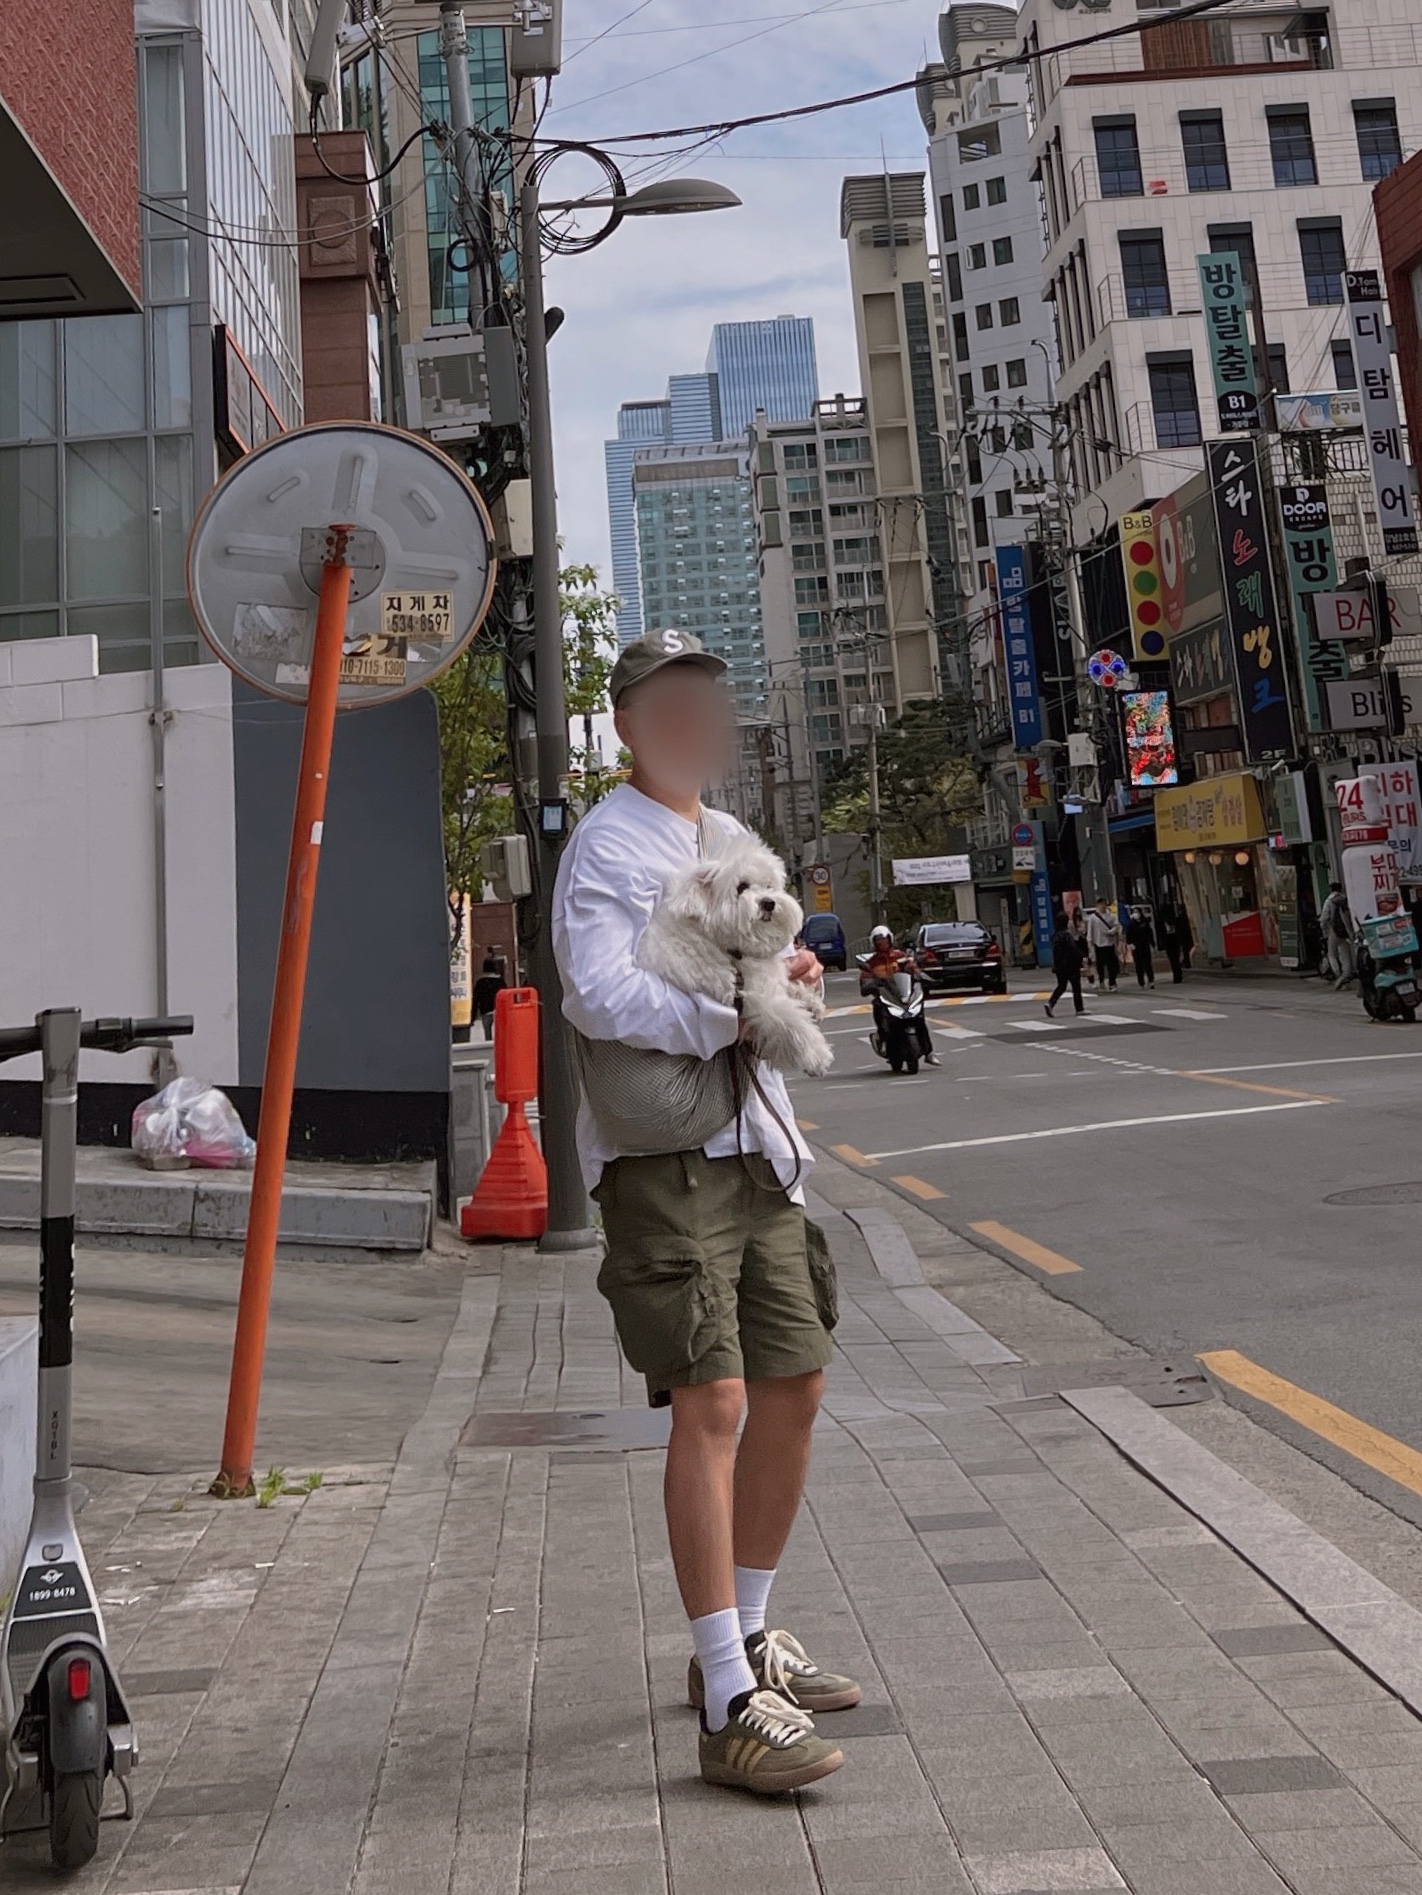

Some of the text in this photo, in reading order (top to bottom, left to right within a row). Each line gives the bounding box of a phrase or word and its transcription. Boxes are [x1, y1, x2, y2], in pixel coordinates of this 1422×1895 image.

[1202, 263, 1248, 382] 방탈출
[1228, 394, 1246, 410] B1
[1355, 312, 1408, 518] 디탐헤어
[1283, 501, 1327, 516] DOOR
[1123, 515, 1152, 530] B&B
[1289, 538, 1345, 681] 방출
[662, 629, 684, 653] S
[1261, 750, 1286, 760] 2F
[815, 869, 828, 881] 30
